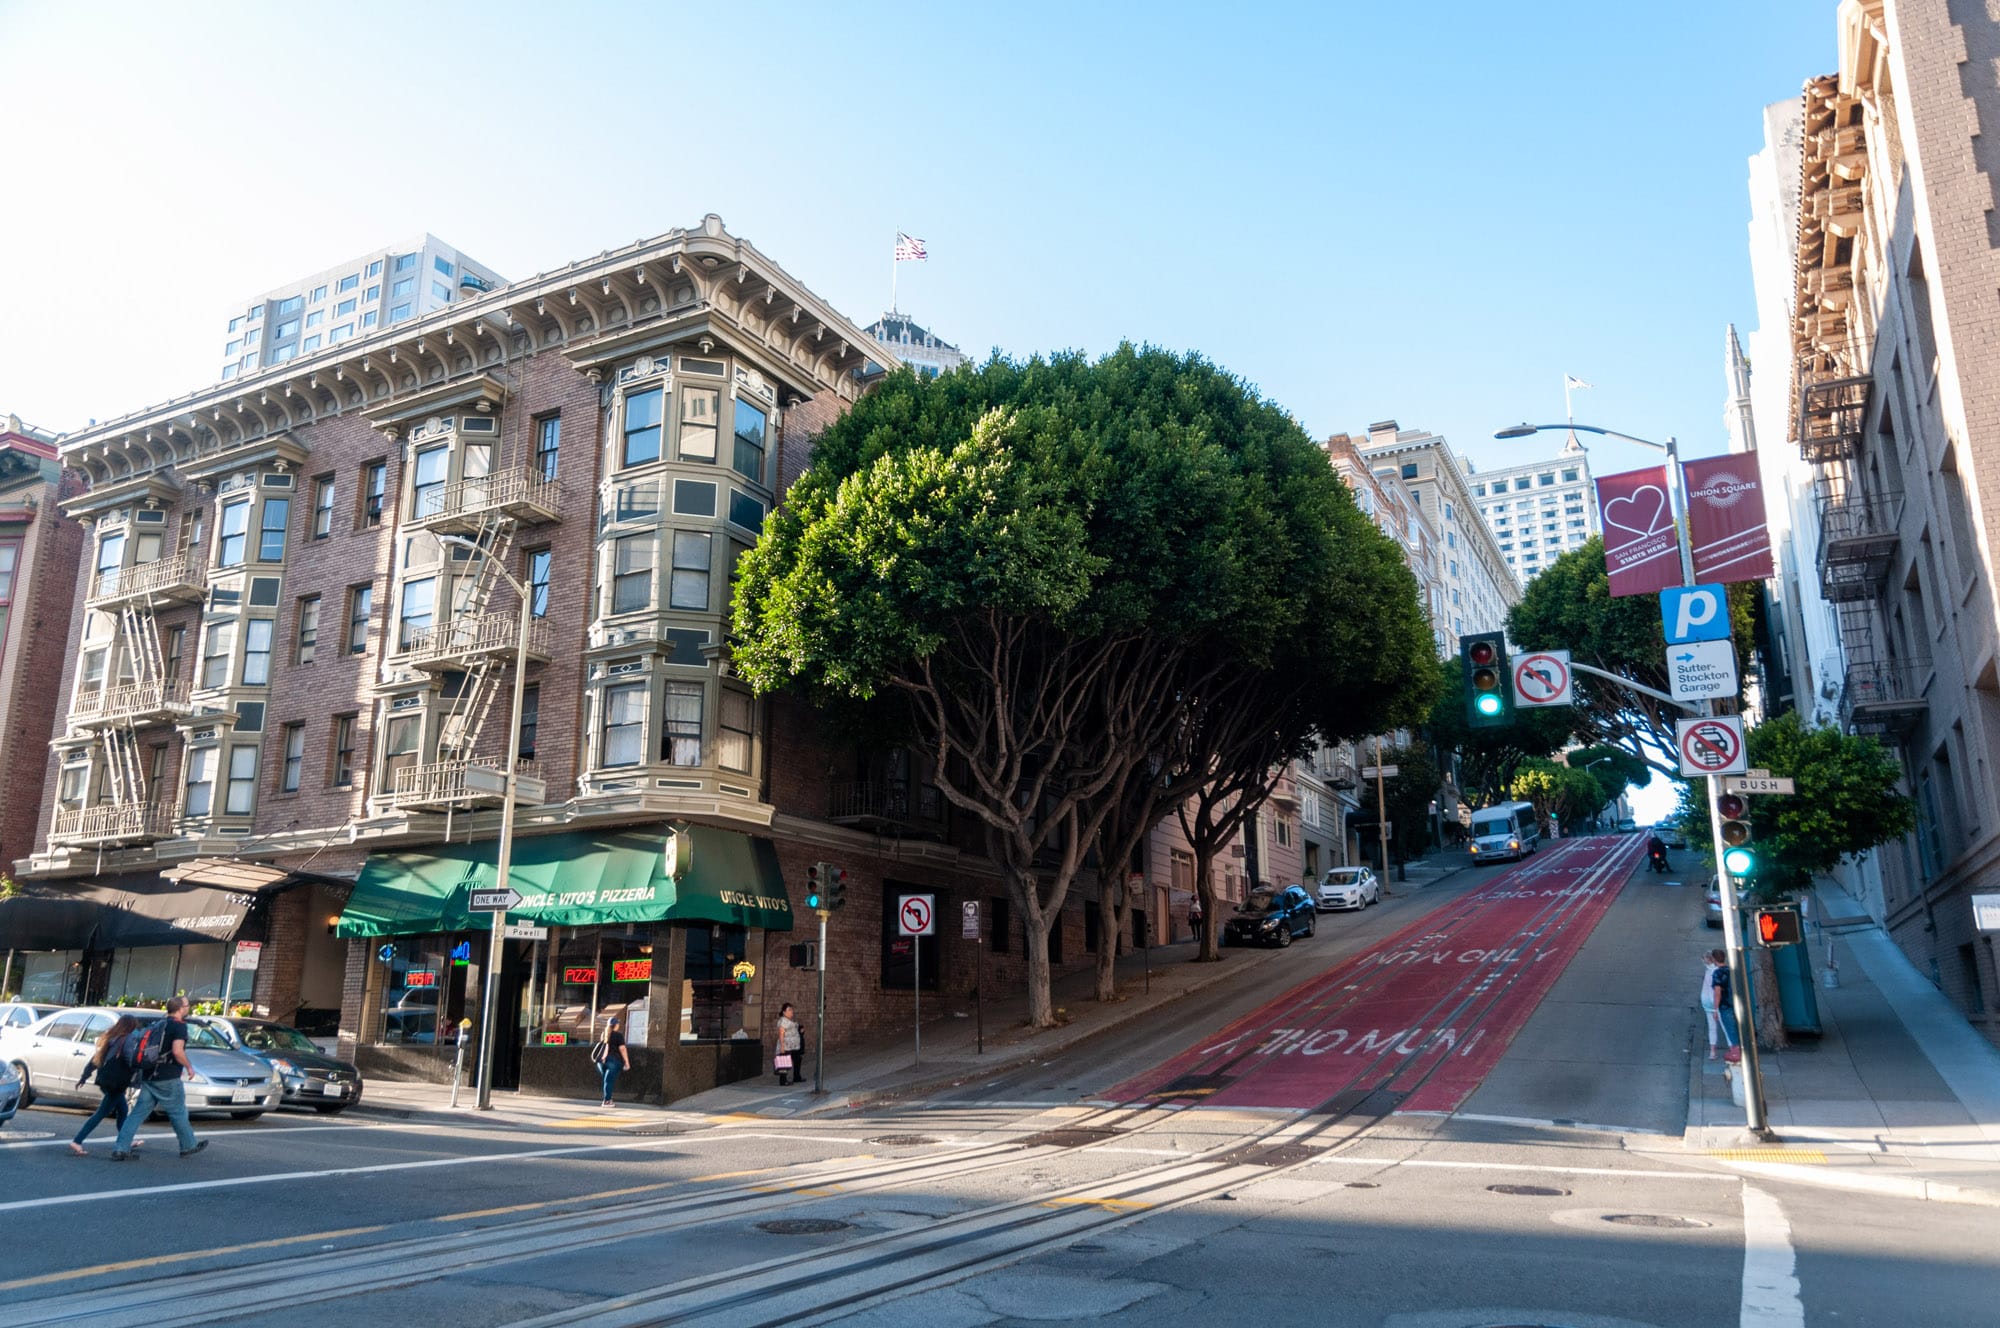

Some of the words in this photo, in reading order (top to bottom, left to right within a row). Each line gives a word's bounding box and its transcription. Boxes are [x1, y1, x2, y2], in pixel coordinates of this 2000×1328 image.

[1690, 487, 1719, 498] UNION
[1722, 482, 1757, 494] SQUARE
[1614, 551, 1629, 561] SAN
[1629, 535, 1667, 554] FRANCISCO
[1620, 551, 1647, 565] STARTS
[1647, 542, 1668, 554] HERE
[1677, 663, 1716, 674] Sutter-
[1678, 671, 1729, 683] Stockton
[1680, 682, 1720, 693] Garage
[1740, 780, 1778, 790] BUSH
[475, 896, 489, 905] ONE
[492, 894, 508, 904] WAY
[559, 890, 597, 905] VITO'S
[600, 886, 656, 904] PIZZERIA
[720, 889, 756, 908] UNCLE
[757, 895, 788, 912] VITO'S
[195, 914, 237, 929] DAUGHTERS
[512, 928, 540, 937] Powell
[1456, 947, 1559, 963] ONLY
[565, 968, 597, 983] PIZZA
[1343, 1028, 1486, 1056] MUNI
